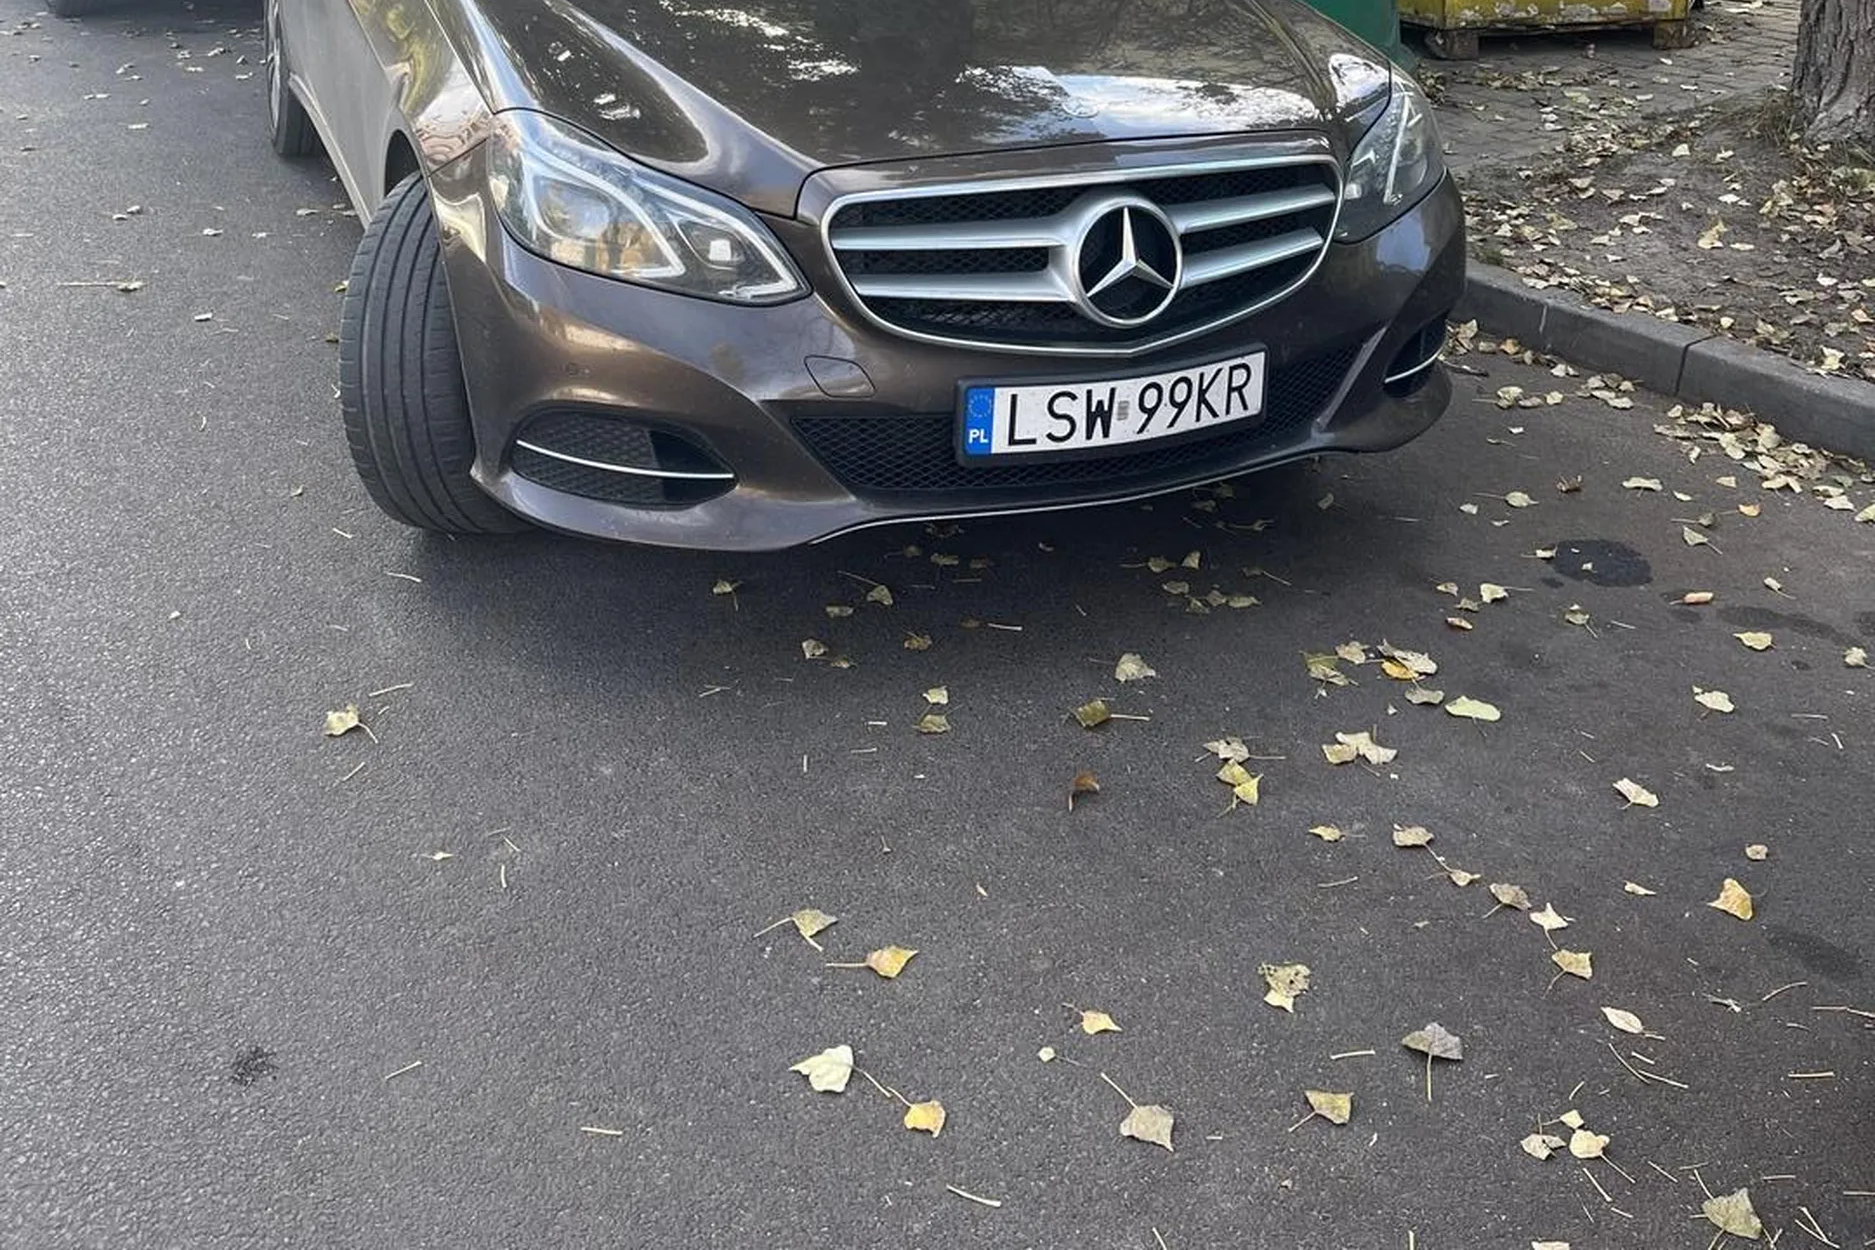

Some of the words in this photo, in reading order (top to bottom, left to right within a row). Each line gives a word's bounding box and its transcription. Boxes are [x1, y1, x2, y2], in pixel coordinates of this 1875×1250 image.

[1007, 387, 1117, 447] LSW
[1136, 361, 1251, 435] 99KR
[968, 428, 989, 444] PL
